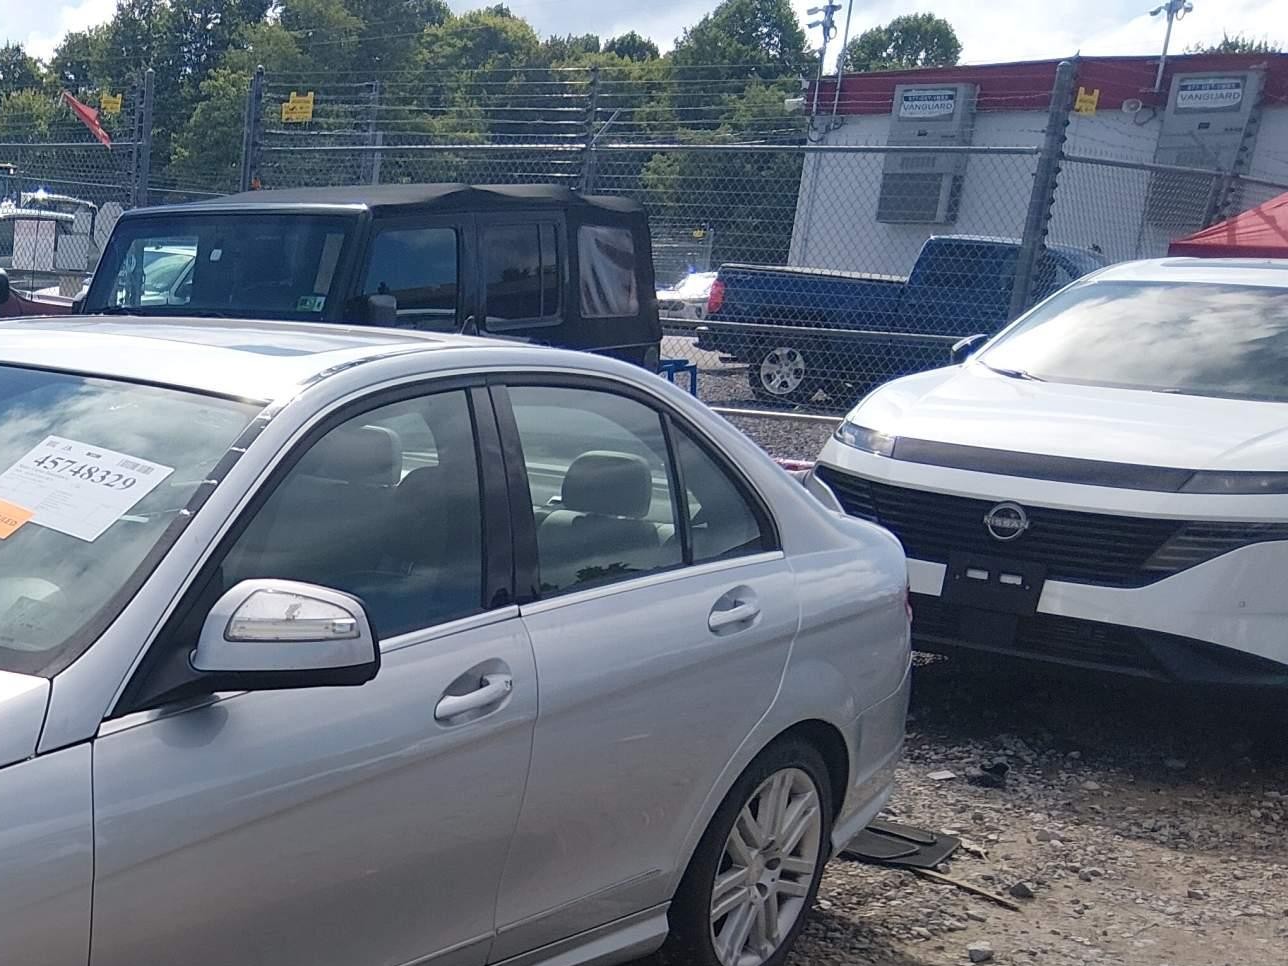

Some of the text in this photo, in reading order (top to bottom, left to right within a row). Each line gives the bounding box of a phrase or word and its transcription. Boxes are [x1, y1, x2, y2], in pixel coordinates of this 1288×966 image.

[1181, 91, 1241, 101] VANGUARD
[903, 102, 953, 111] VANGUARD
[33, 454, 137, 490] 45748329
[984, 515, 1030, 529] NISSAN
